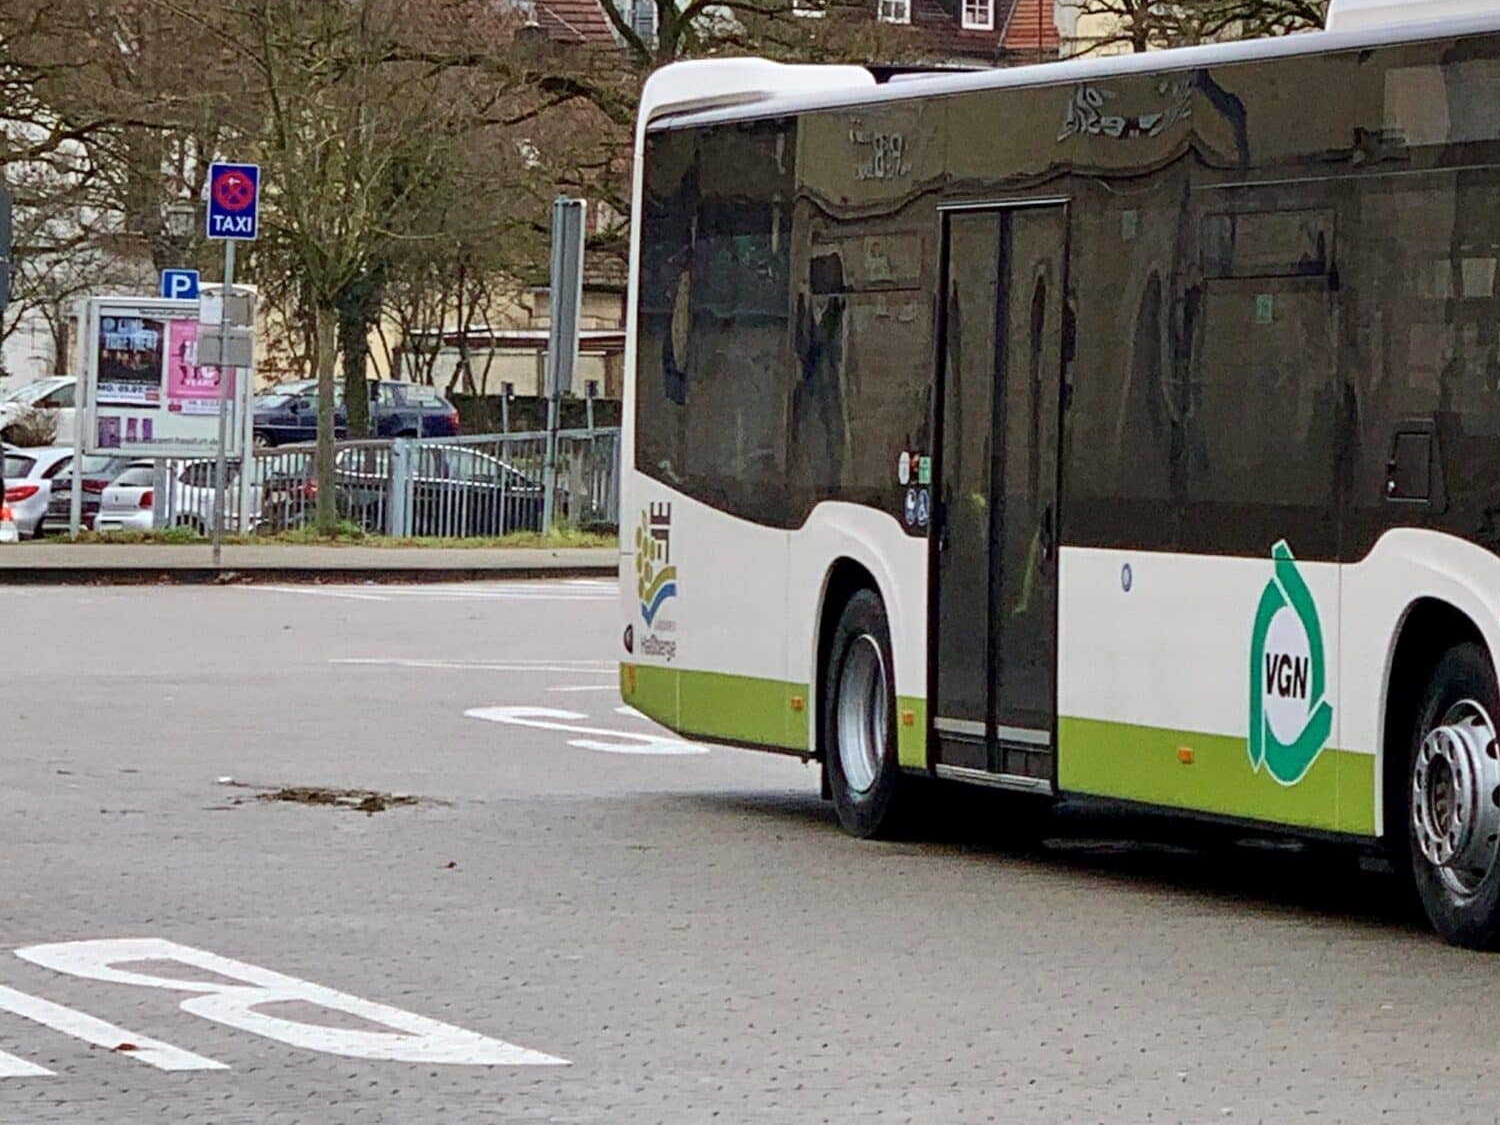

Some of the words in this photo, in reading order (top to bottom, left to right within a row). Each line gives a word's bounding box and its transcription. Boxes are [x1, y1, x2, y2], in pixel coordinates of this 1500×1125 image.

[212, 215, 253, 232] TAXI
[171, 274, 192, 299] P
[1266, 652, 1309, 699] VGN
